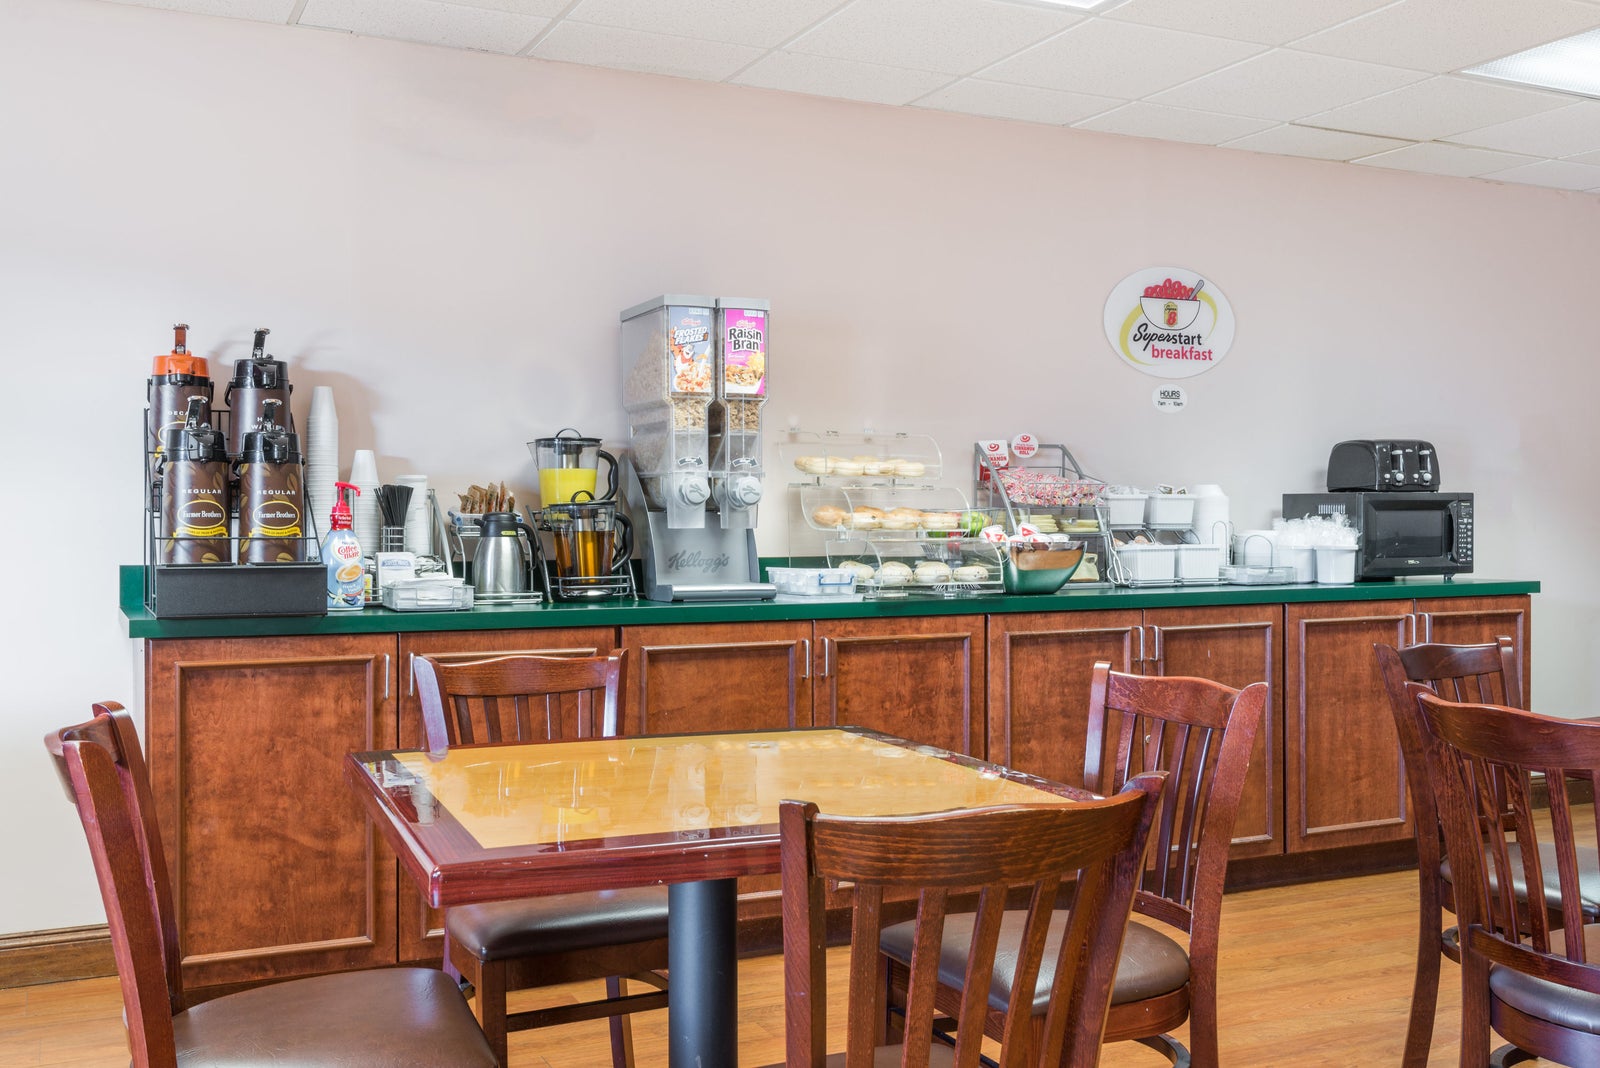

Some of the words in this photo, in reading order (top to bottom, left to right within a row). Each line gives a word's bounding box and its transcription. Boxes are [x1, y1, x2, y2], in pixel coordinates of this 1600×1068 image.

[674, 326, 708, 339] FROSTED
[728, 327, 762, 342] Raisin
[674, 334, 704, 345] FLAKES
[732, 339, 760, 351] Bran
[1151, 344, 1213, 361] breakfast
[1159, 390, 1181, 398] HOURS
[337, 545, 358, 556] Coffee
[668, 549, 730, 573] Kellogg's
